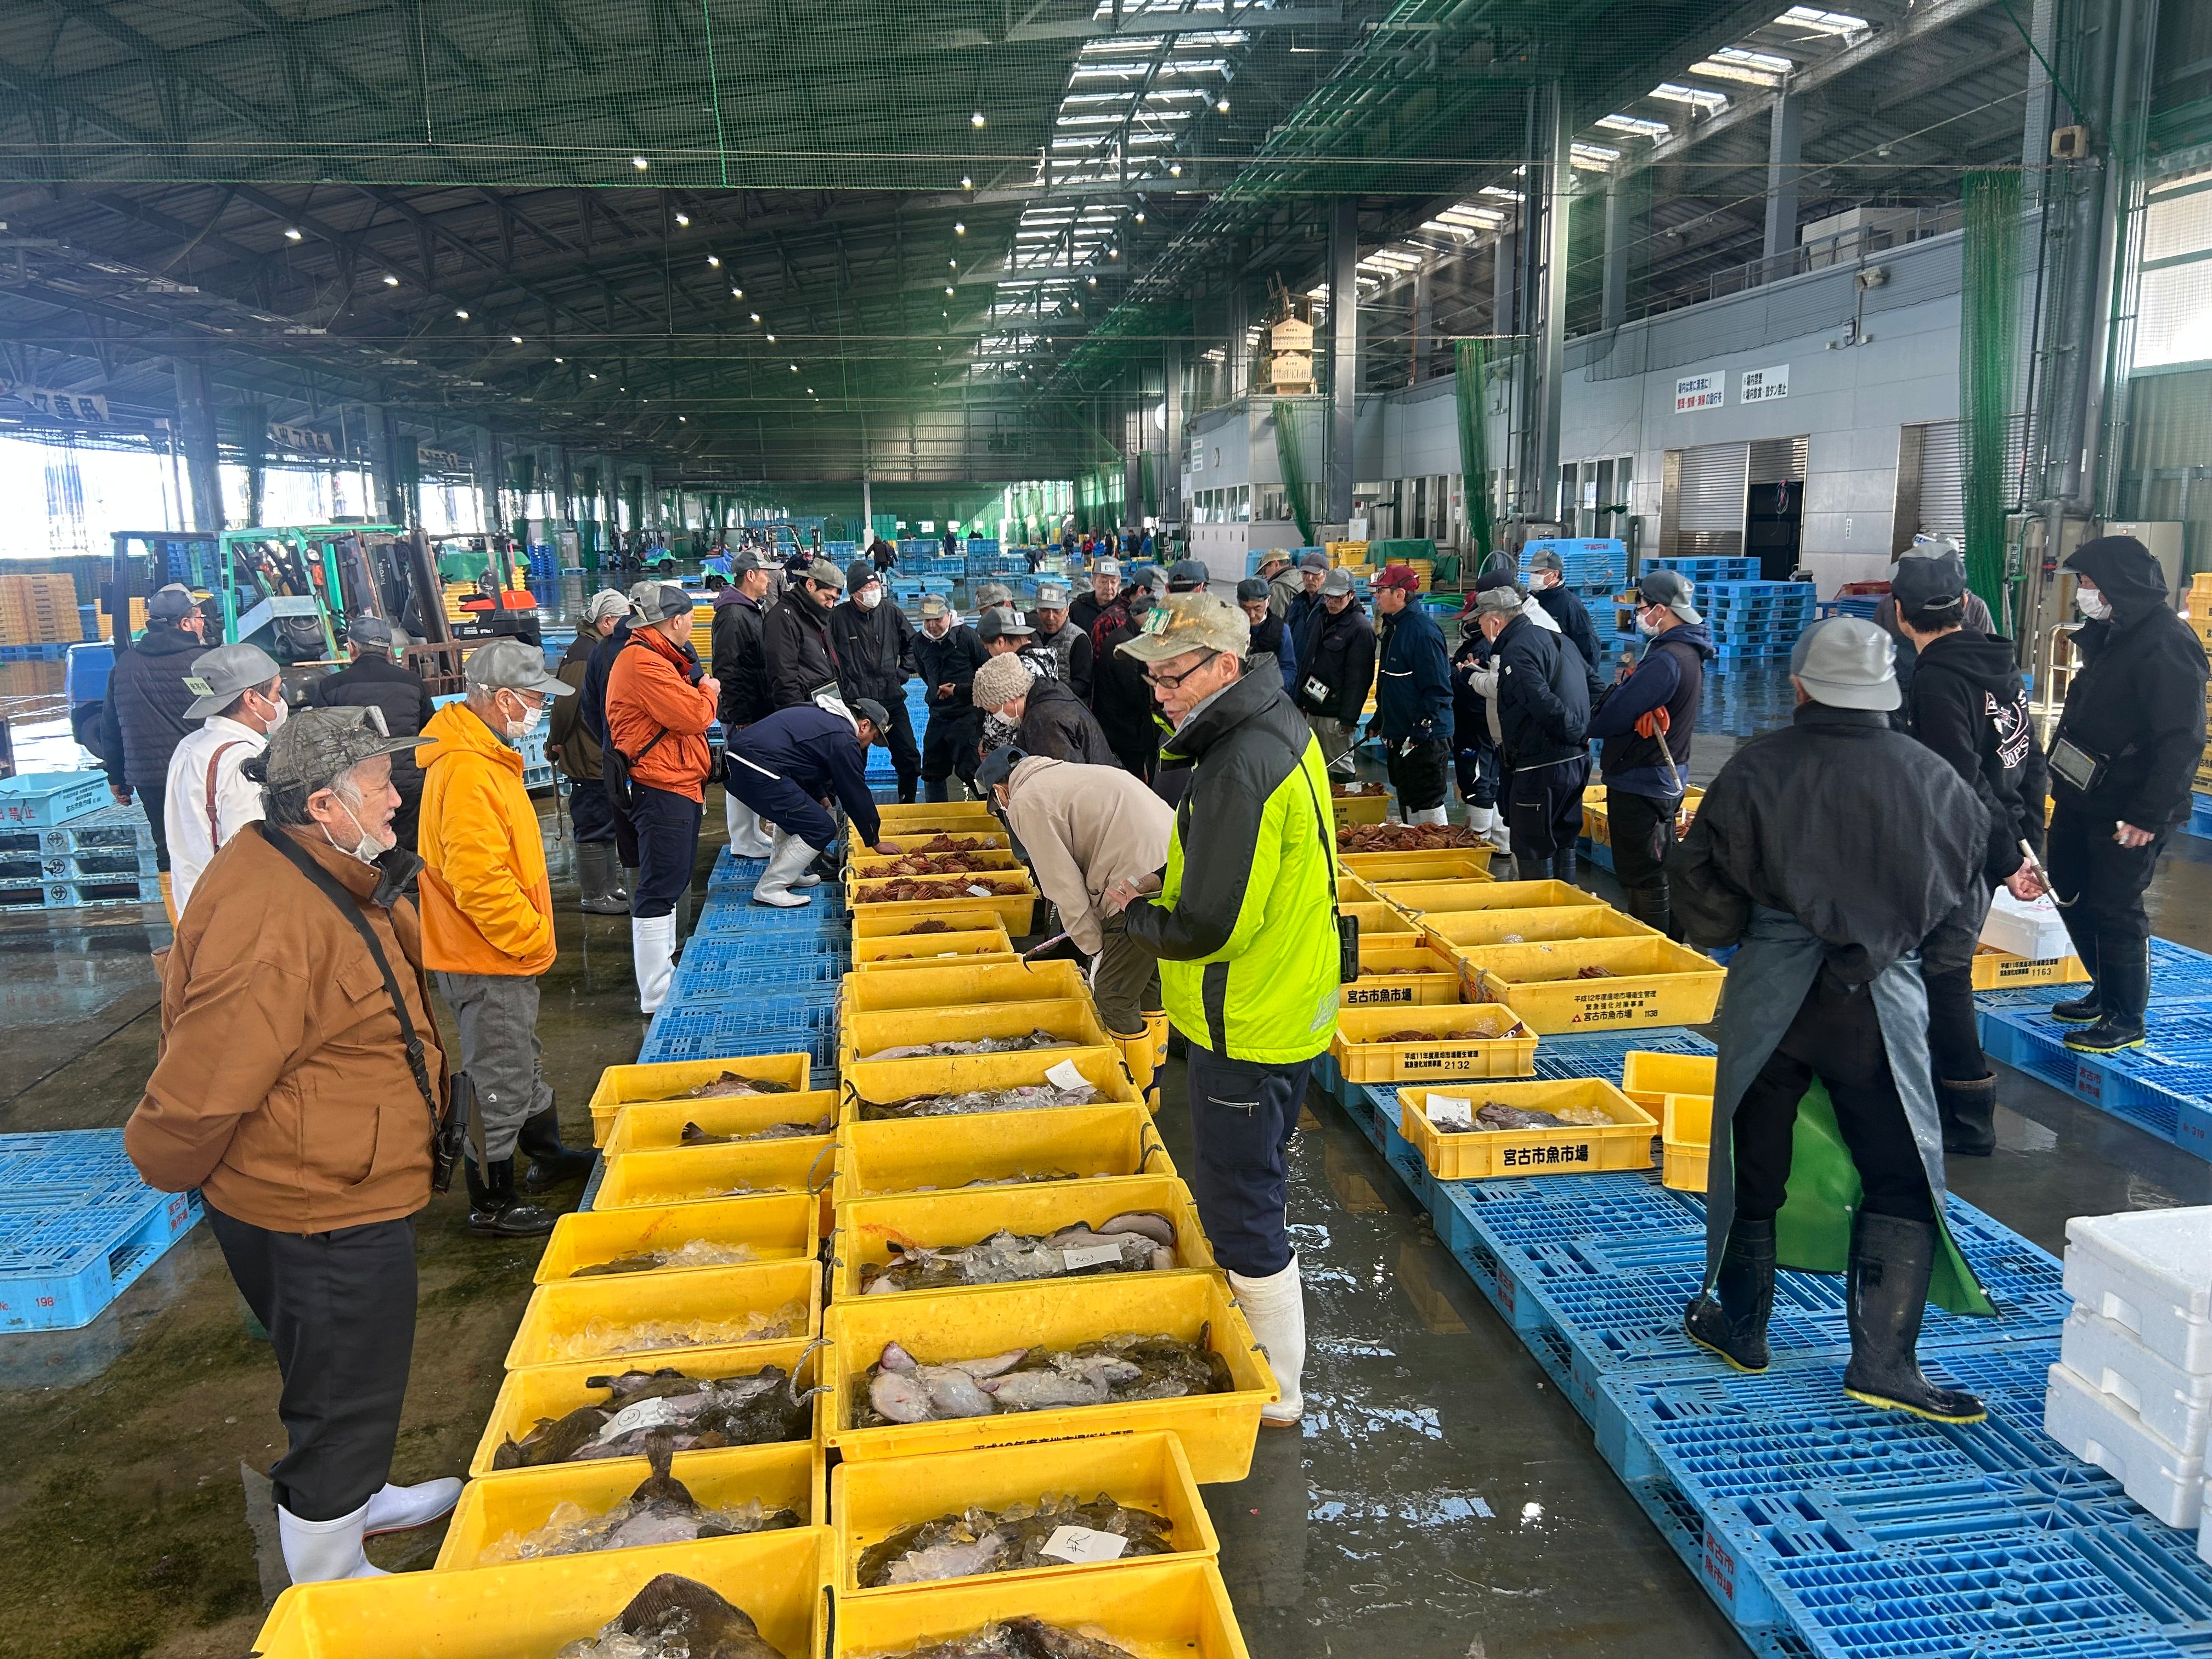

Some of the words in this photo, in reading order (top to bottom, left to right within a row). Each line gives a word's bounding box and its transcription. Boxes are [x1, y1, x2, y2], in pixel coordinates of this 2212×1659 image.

[2032, 968, 2052, 977] 1163
[1347, 988, 1412, 1003] 宮古市魚市場
[1583, 1009, 1633, 1022] 宮古市魚市場
[1444, 1060, 1470, 1070] 2132
[1503, 1144, 1589, 1166] 宮古市魚市場
[168, 1193, 186, 1216] 宮古市
[36, 1296, 54, 1307] 198
[1706, 1530, 1734, 1576] 宮古市
[1705, 1554, 1733, 1601] 魚市場
